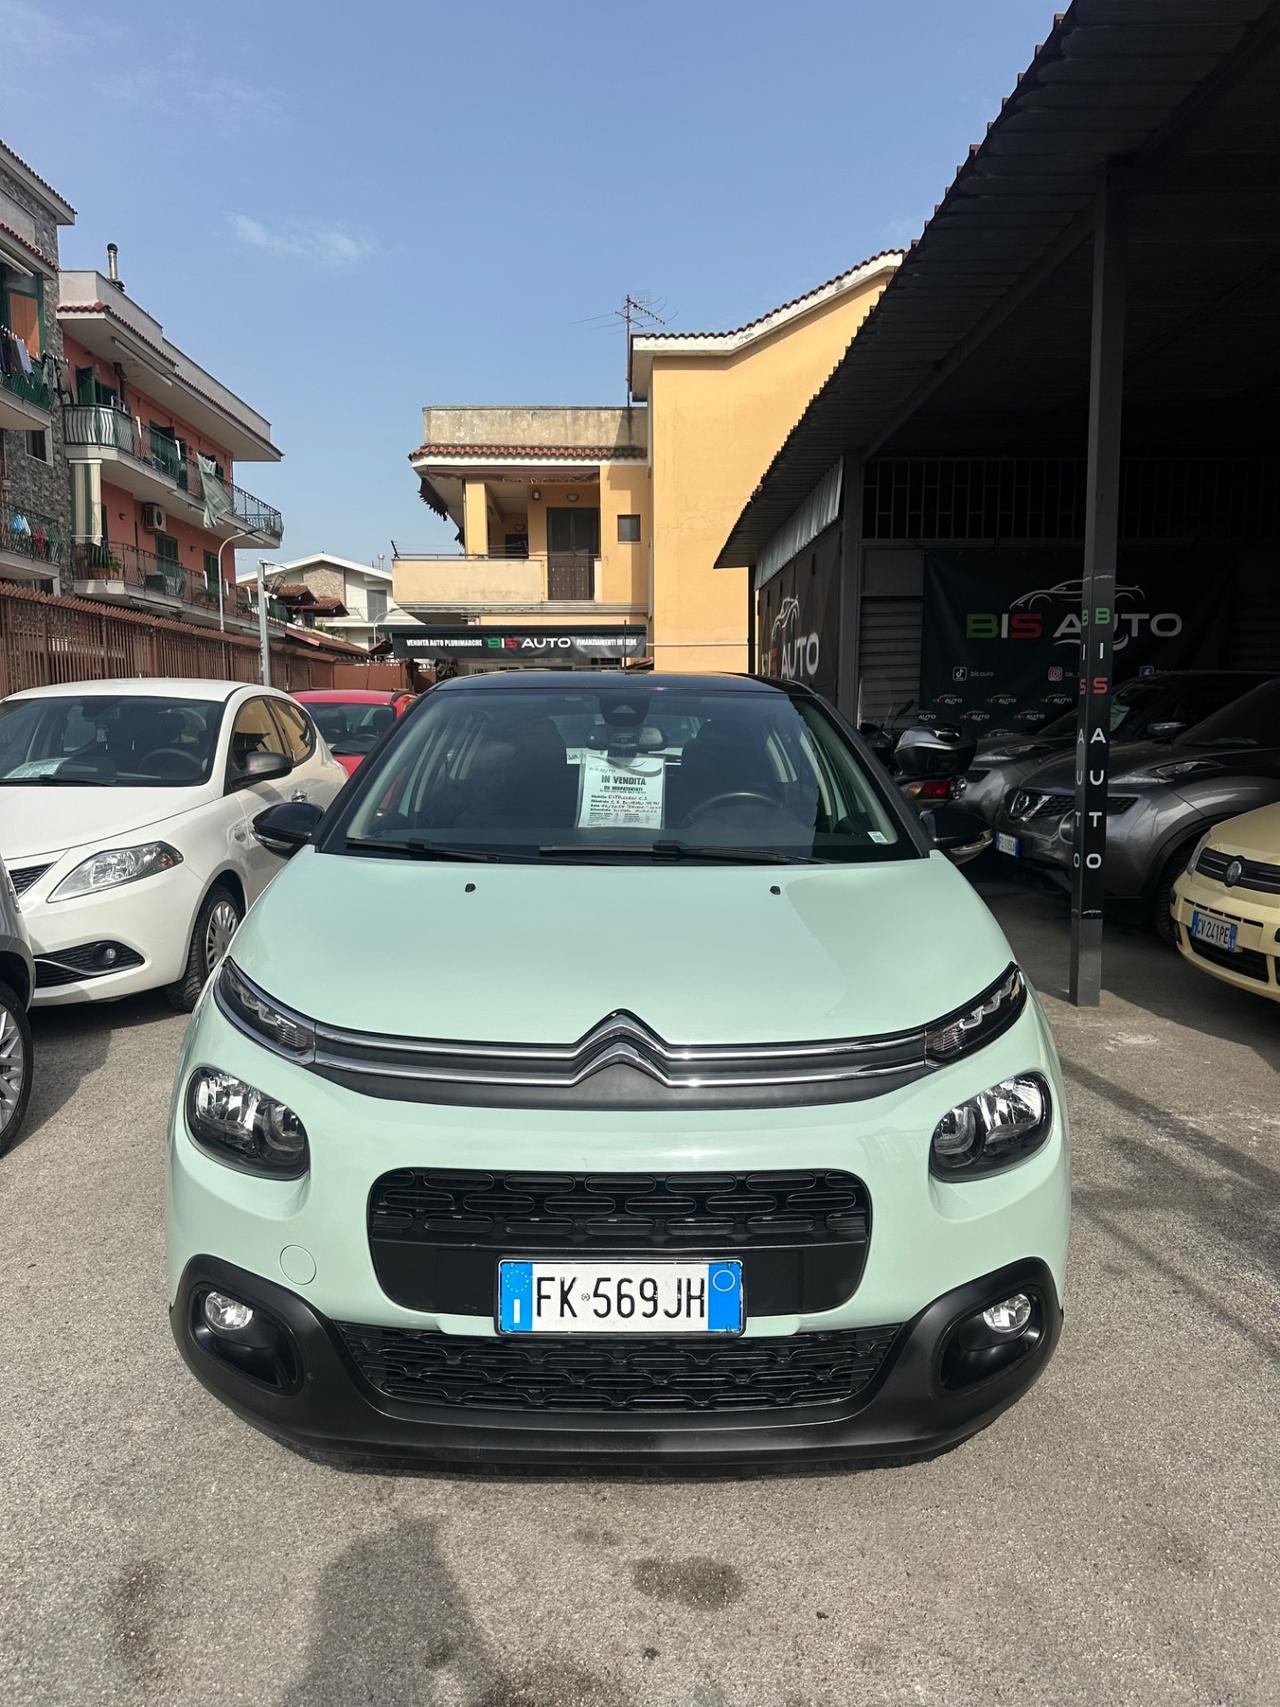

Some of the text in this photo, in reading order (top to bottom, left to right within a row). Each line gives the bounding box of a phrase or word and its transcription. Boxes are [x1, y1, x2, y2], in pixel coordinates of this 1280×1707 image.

[966, 613, 1043, 639] BIS
[406, 639, 429, 647] VENDITA
[429, 639, 444, 647] AUTO
[444, 639, 483, 647] PLURIMARCHE
[488, 638, 517, 648] BIS
[521, 637, 571, 648] AUTO
[781, 632, 820, 679] AUTO
[601, 775, 646, 785] IN VENDITA
[536, 1276, 578, 1318] FK
[592, 1277, 706, 1319] 569JH
